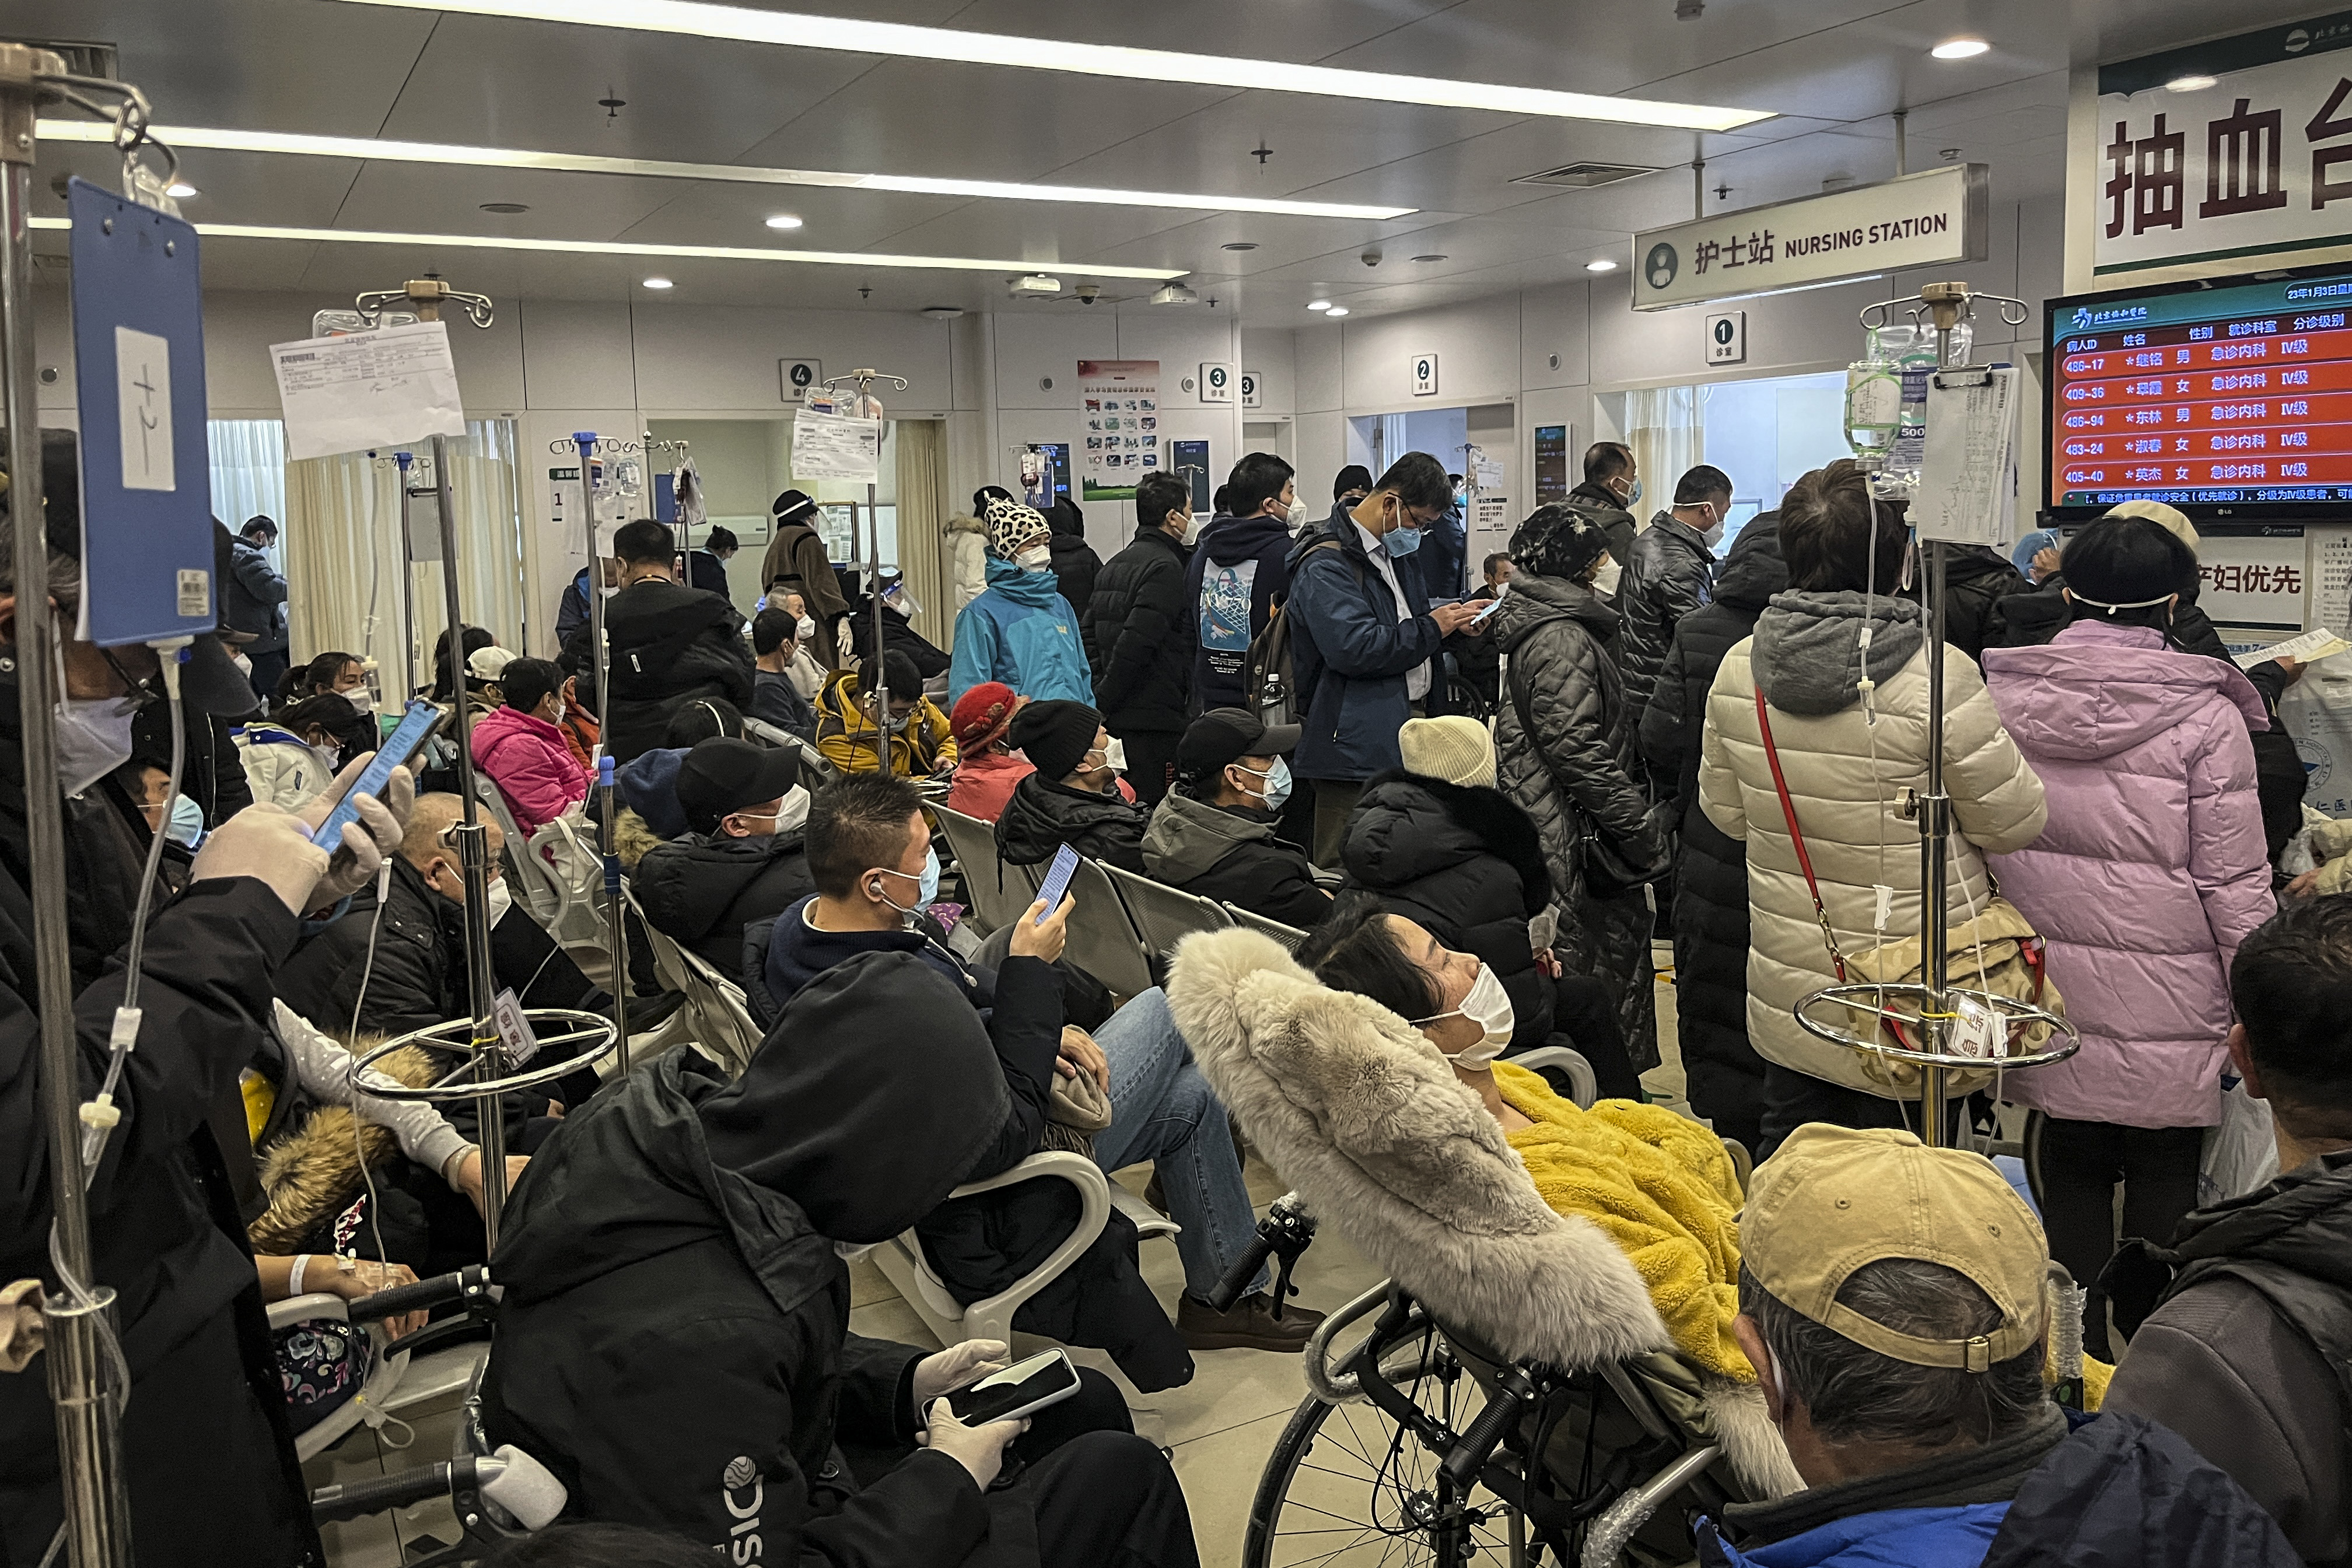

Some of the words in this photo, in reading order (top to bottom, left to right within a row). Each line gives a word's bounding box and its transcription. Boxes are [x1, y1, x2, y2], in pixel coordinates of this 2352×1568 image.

[1695, 229, 1774, 275] 护士站
[1785, 228, 1863, 258] NURSING
[1868, 212, 1947, 244] STATION
[1719, 324, 1726, 341] 1
[2067, 340, 2098, 352] 病人ID
[2123, 334, 2146, 347] 姓名
[2189, 326, 2213, 341] 性别
[2228, 320, 2277, 337] 就诊科室
[2294, 313, 2345, 330] 分诊级别
[2176, 349, 2190, 364] 男
[2211, 342, 2267, 361] 急诊内科
[795, 367, 805, 383] 4
[1213, 371, 1222, 385] 3
[1420, 363, 1426, 377] 2
[1242, 379, 1250, 393] 3
[2176, 379, 2190, 393] 女
[2211, 373, 2267, 391] 急诊内科
[2176, 408, 2190, 422] 男
[2211, 403, 2266, 420] 急诊内科
[1901, 428, 1925, 437] 500
[2175, 438, 2189, 452] 女
[2210, 433, 2266, 450] 急诊内科
[2175, 466, 2189, 481] 女
[2210, 464, 2266, 480] 急诊内科
[723, 1475, 764, 1568] DIS
